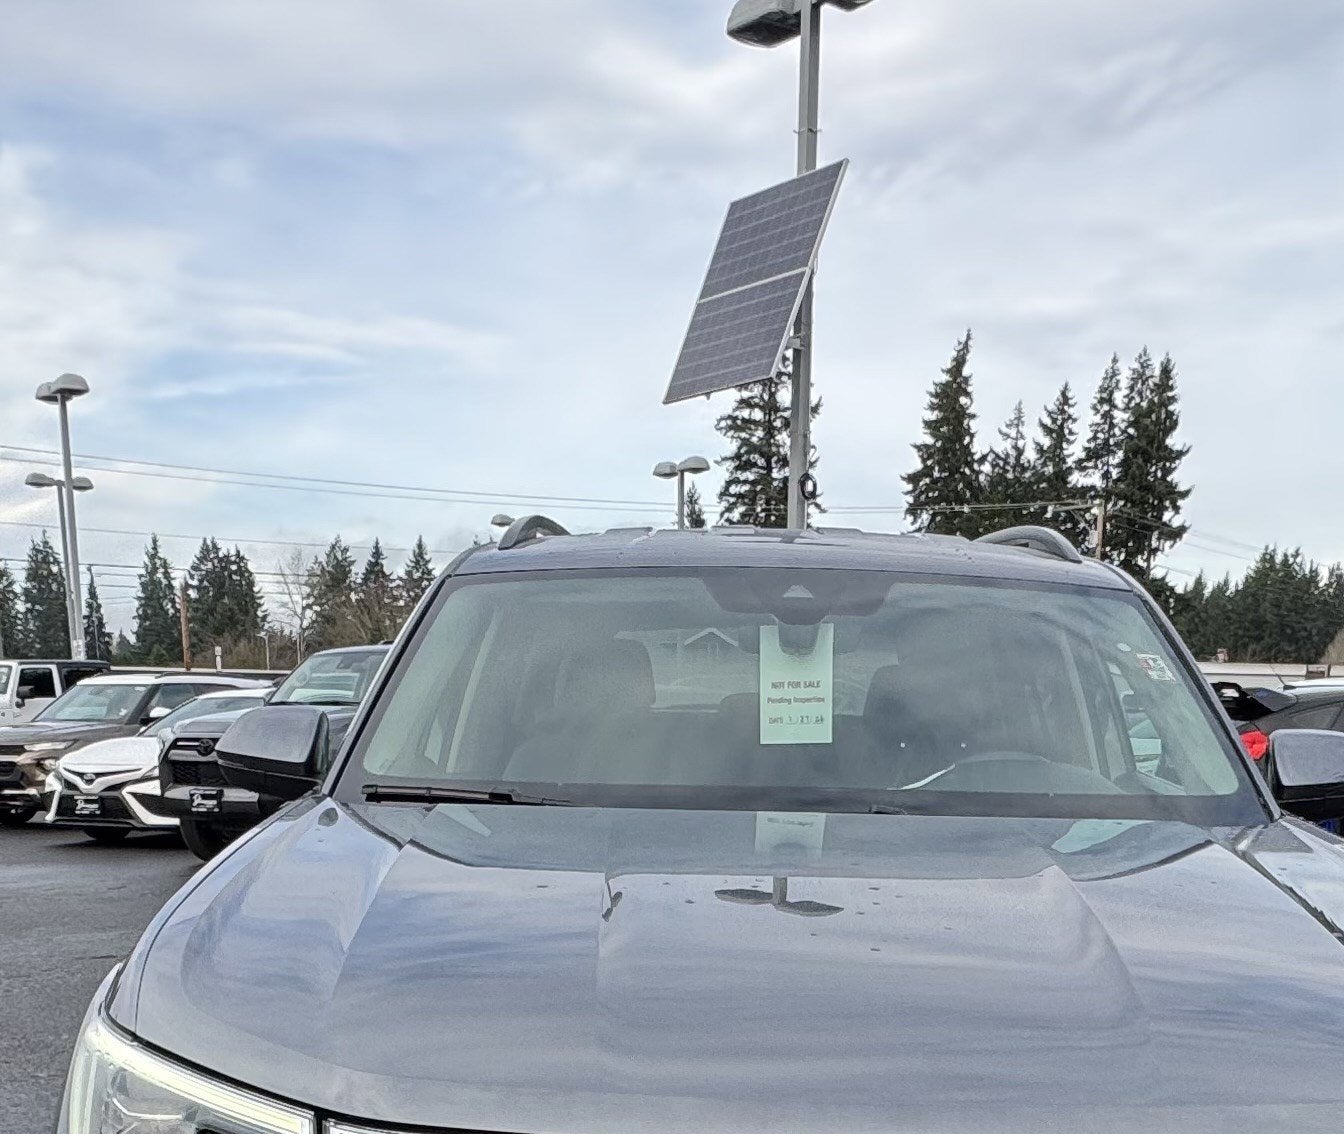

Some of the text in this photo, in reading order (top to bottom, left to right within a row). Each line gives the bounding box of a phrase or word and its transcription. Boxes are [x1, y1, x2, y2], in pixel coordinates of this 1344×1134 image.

[771, 680, 821, 689] NOT FOR SALE
